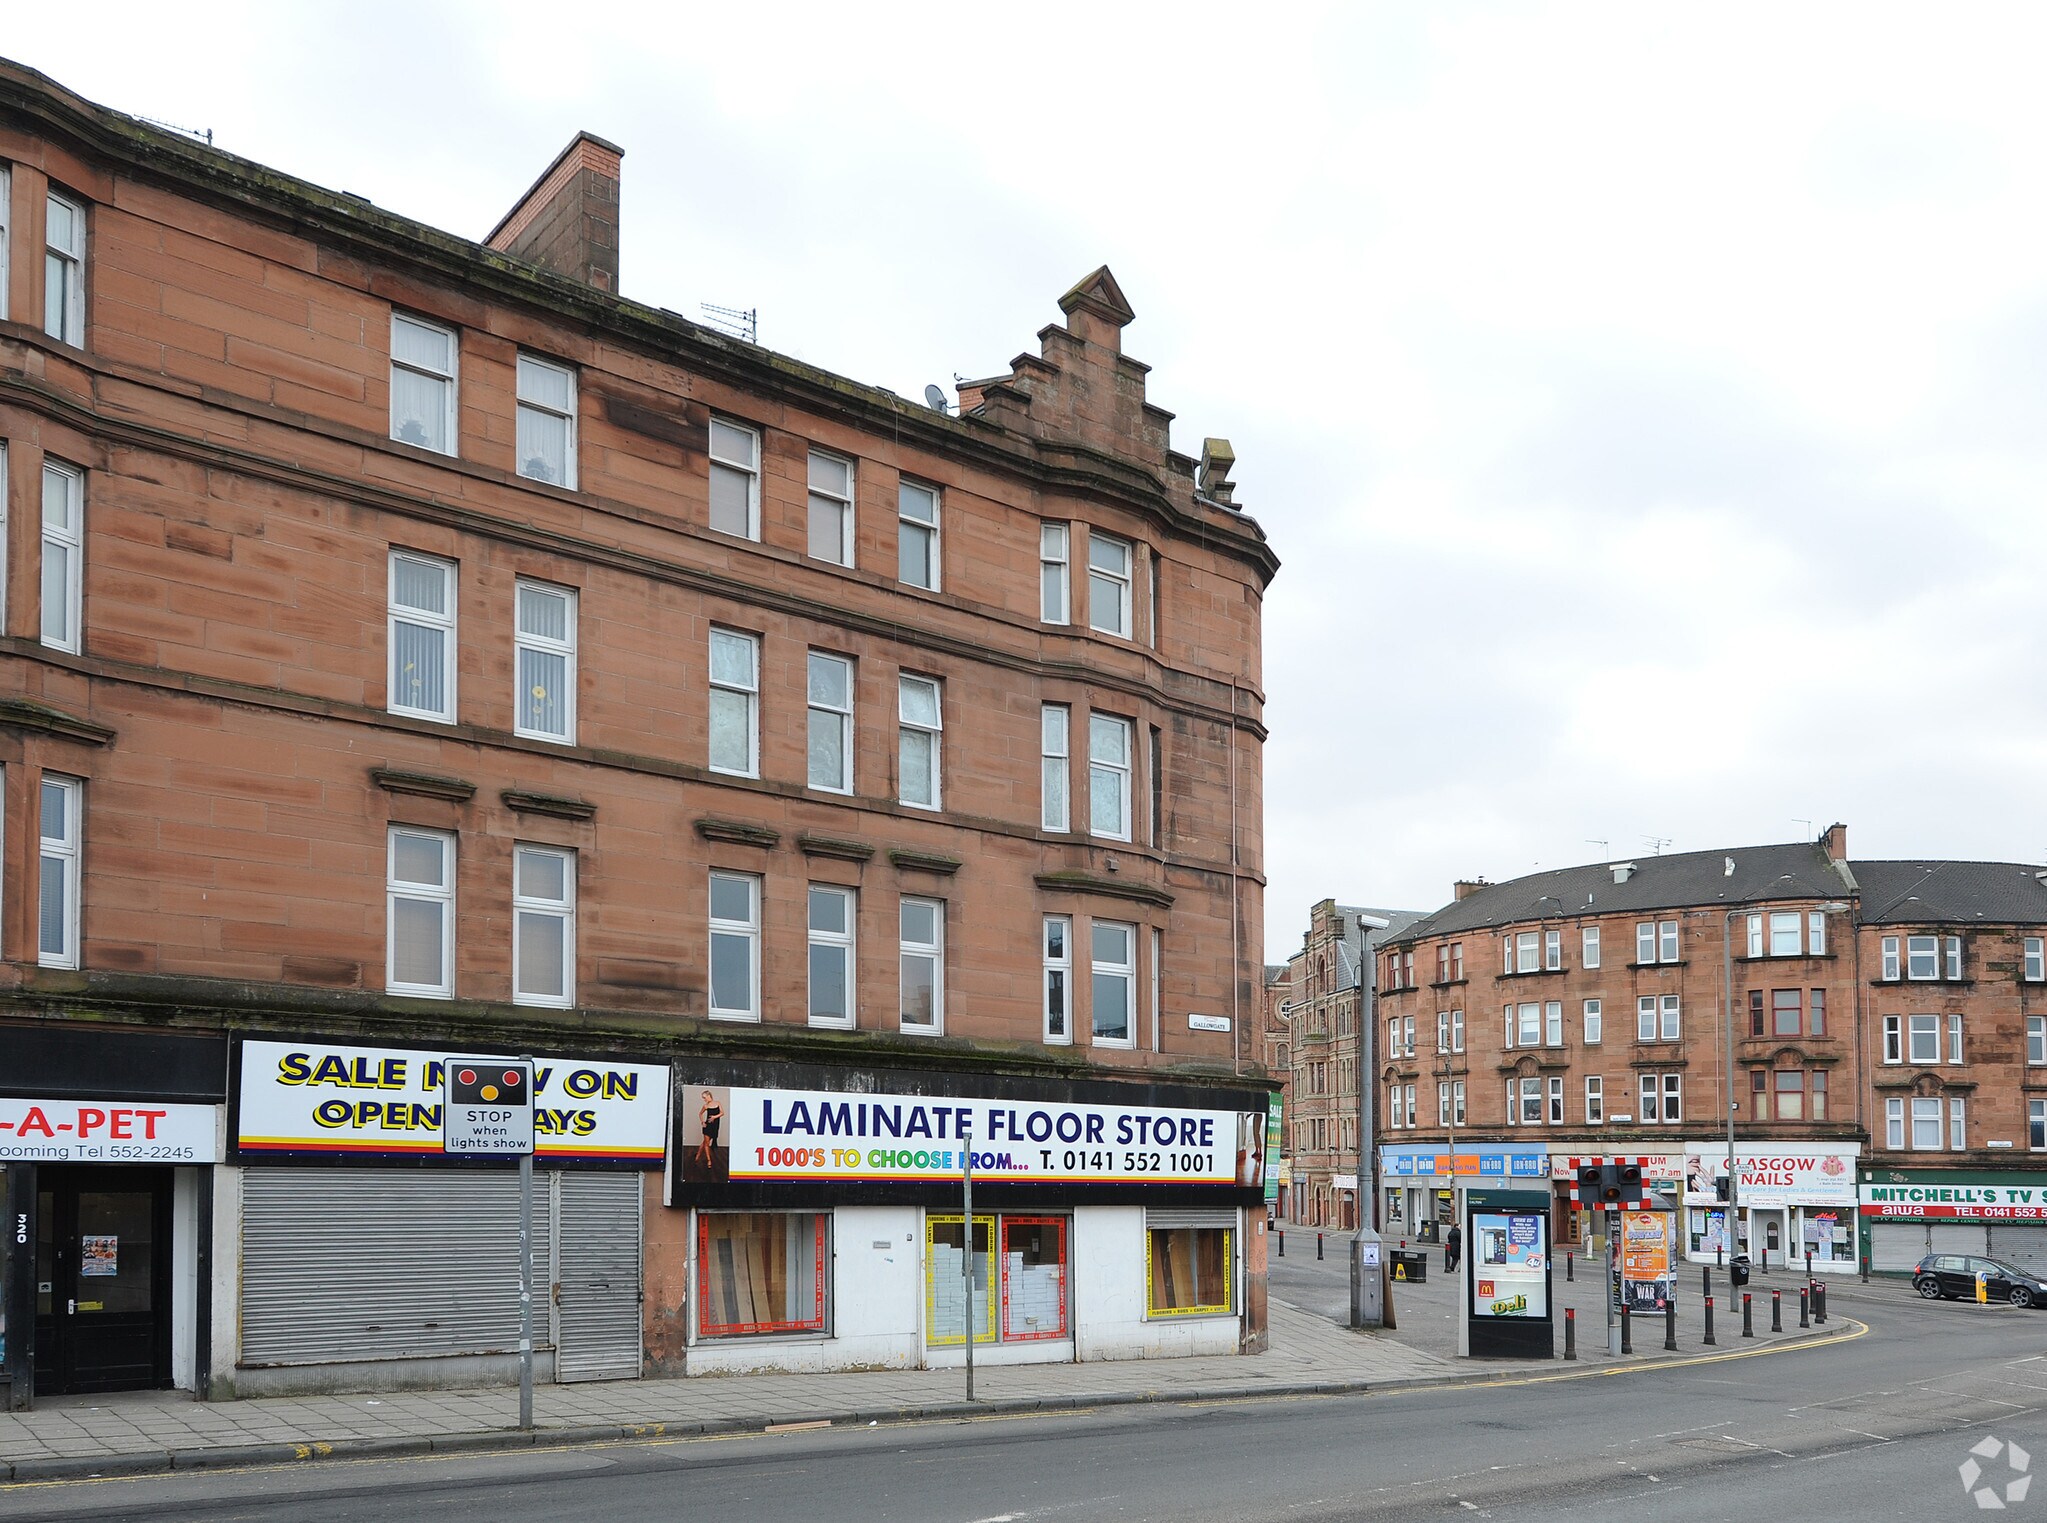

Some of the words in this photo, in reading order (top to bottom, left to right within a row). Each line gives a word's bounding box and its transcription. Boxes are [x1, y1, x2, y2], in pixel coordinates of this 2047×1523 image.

[276, 1053, 407, 1090] SALE
[563, 1070, 638, 1100] ON
[312, 1100, 444, 1130] OPEN
[534, 1108, 597, 1136] AYS
[467, 1111, 512, 1123] STOP
[1270, 1104, 1282, 1118] SALE
[763, 1100, 972, 1140] LAMINATE
[988, 1109, 1104, 1143] FLOOR
[1116, 1115, 1214, 1146] STORE
[472, 1126, 507, 1136] when
[452, 1138, 489, 1149] lights
[494, 1139, 527, 1148] show
[75, 1144, 103, 1158] Tel
[110, 1146, 194, 1158] 552-2245
[756, 1148, 825, 1166] 1000'S
[832, 1149, 861, 1168] TO
[868, 1150, 952, 1169] CHOOSE
[1040, 1150, 1055, 1170] T.
[1064, 1151, 1114, 1171] 0141
[1124, 1152, 1160, 1172] 552
[1170, 1154, 1213, 1172] 1001
[1741, 1173, 1793, 1186] NAILS
[1872, 1188, 1997, 1202] MITCHELL'S
[2006, 1190, 2033, 1203] TV
[1882, 1206, 1924, 1215] aiwa
[1954, 1207, 1979, 1216] TEL:
[1984, 1208, 2010, 1217] 0141
[2015, 1208, 2036, 1217] 552
[17, 1214, 27, 1243] 320
[1636, 1287, 1655, 1300] WAR
[1491, 1294, 1527, 1314] Deli
